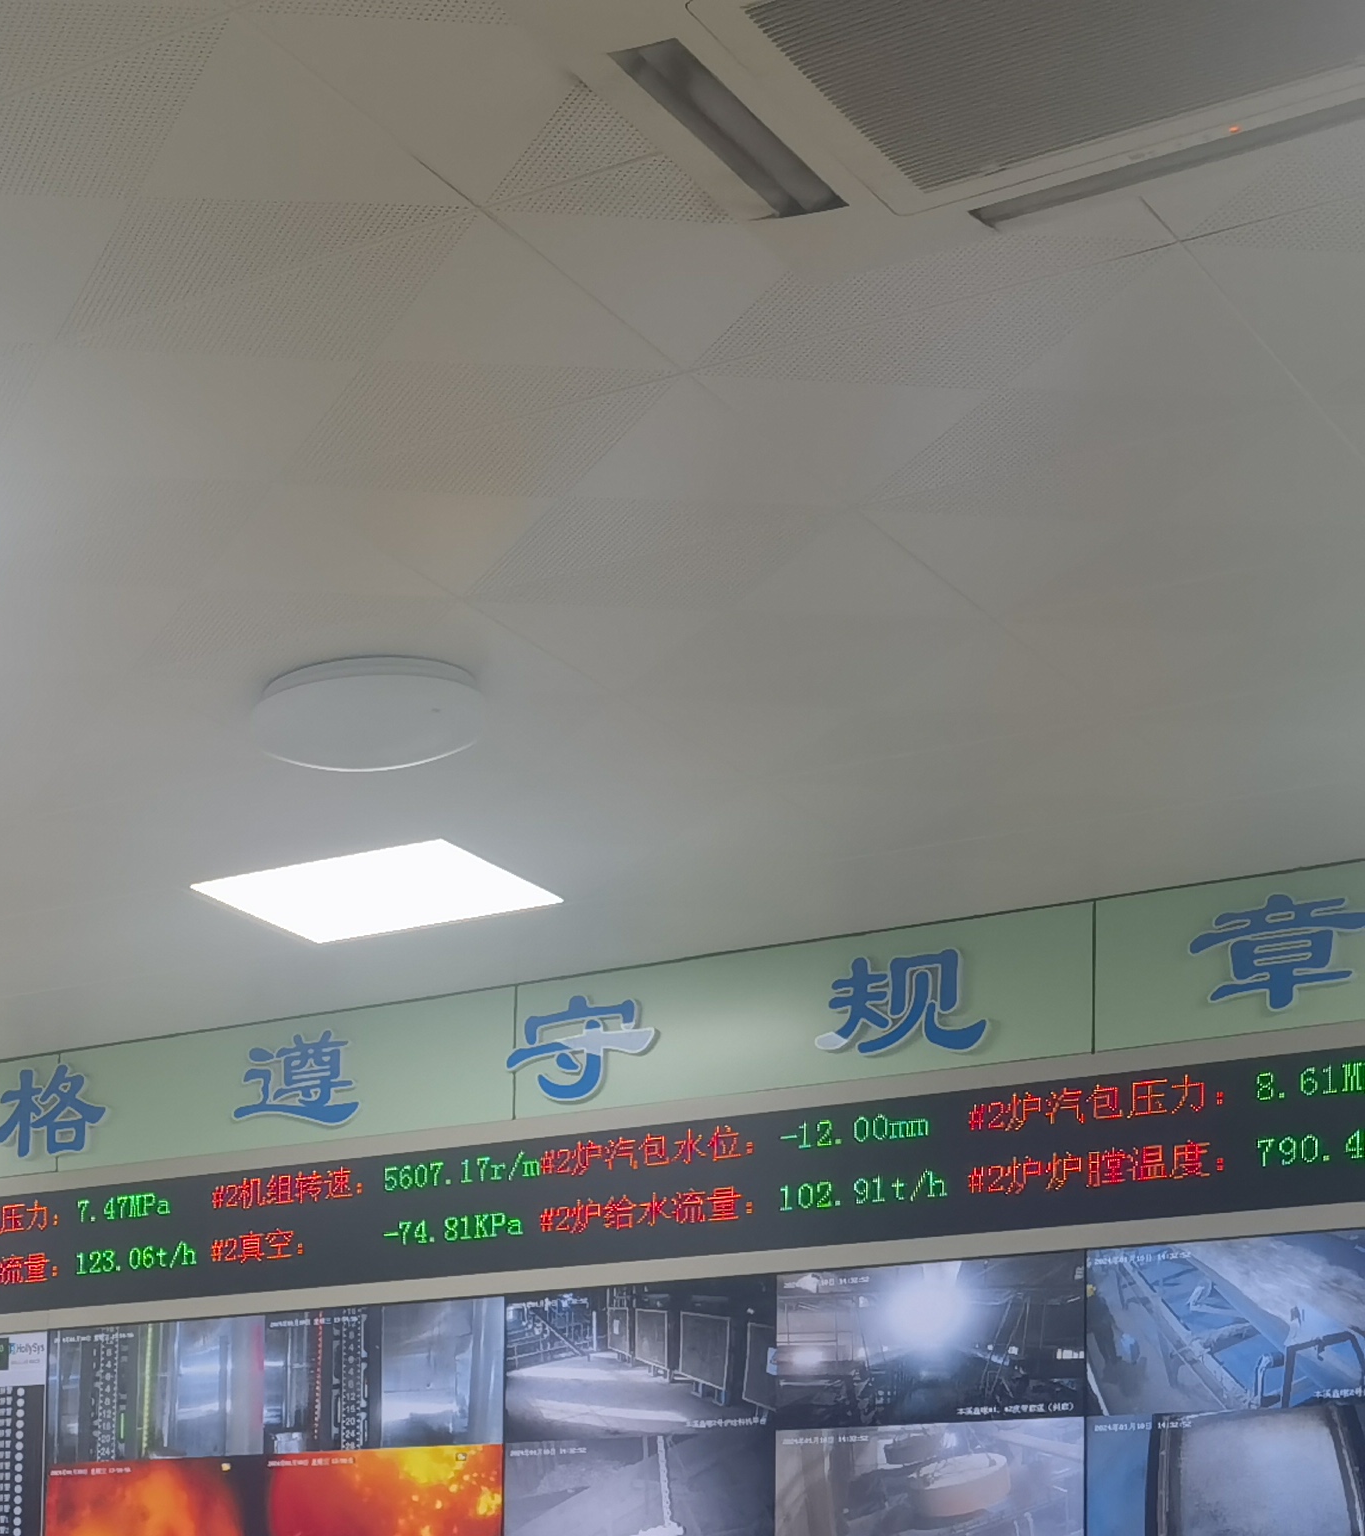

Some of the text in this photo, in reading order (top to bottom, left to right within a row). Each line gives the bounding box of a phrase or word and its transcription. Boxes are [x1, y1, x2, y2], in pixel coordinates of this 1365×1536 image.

[968, 1075, 1224, 1132] #2炉汽包压力：
[540, 1113, 929, 1177] #2炉汽包水位： -12.00mm
[968, 1140, 1224, 1195] #2炉炉膛温度：
[211, 1150, 540, 1209] #2机组转速： 5607.17r/m
[540, 1168, 948, 1234] #2炉给水流量： 102.91t/h
[76, 1192, 170, 1223] 7.47MPa
[76, 1241, 196, 1275] 123.06t/h
[211, 1213, 523, 1264] #2真空： -74.81KPa
[16, 1342, 45, 1355] HollySys
